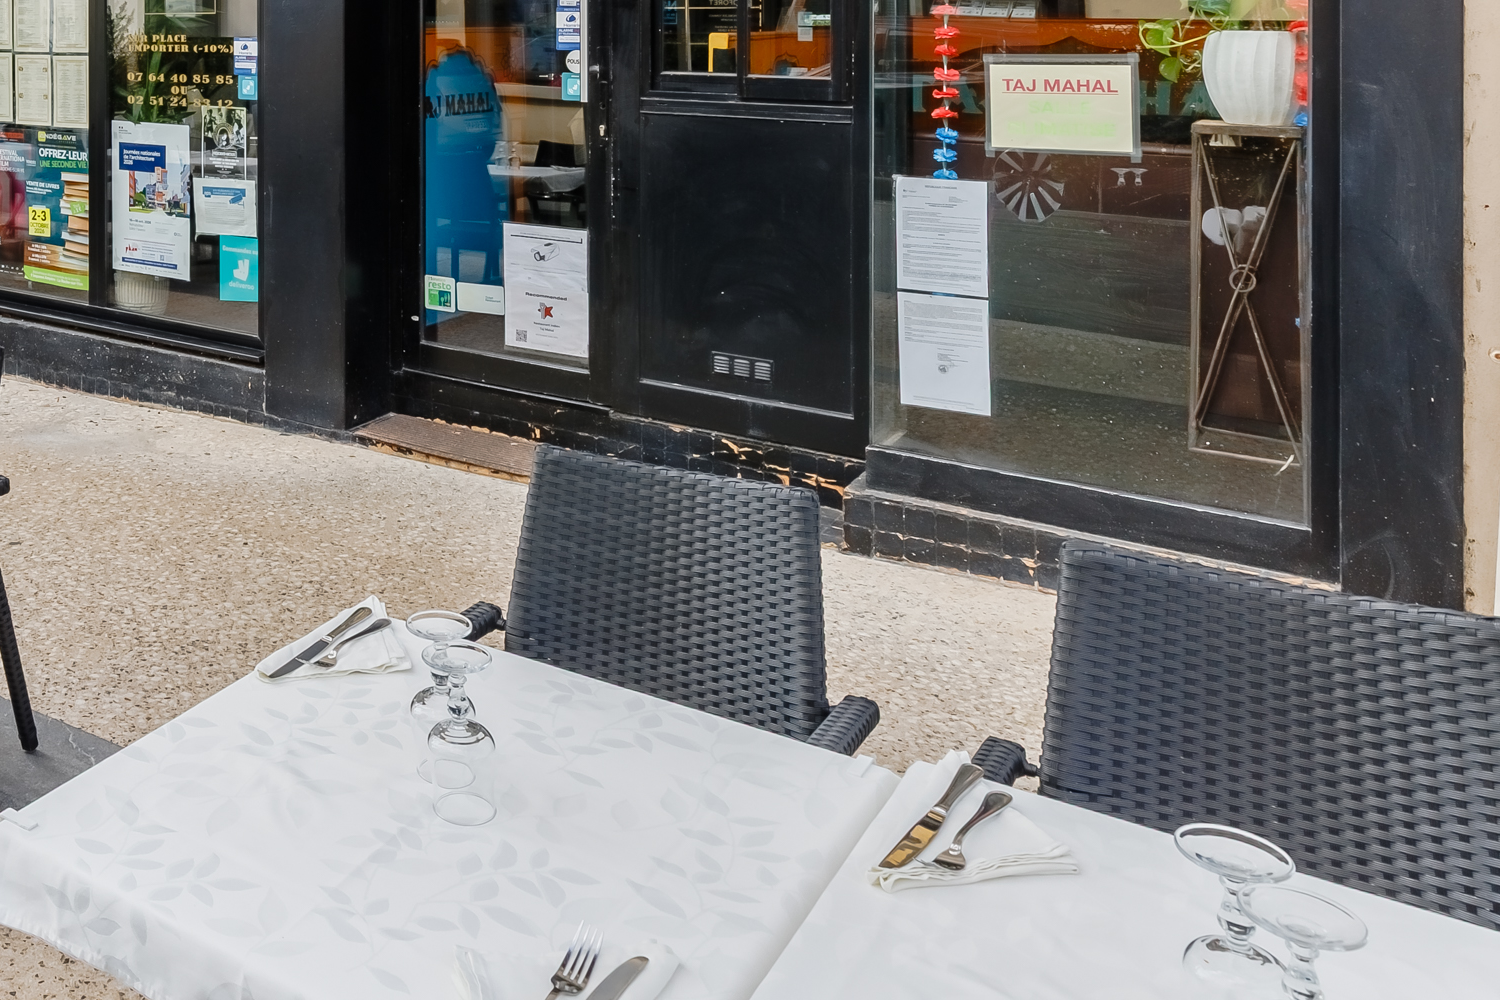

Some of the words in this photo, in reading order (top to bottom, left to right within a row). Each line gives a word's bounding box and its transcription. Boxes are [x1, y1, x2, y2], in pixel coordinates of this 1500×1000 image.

[152, 34, 187, 43] PLACE
[193, 44, 234, 54] (-10%)
[127, 72, 144, 82] 07
[148, 72, 165, 82] 64
[170, 73, 187, 83] 40
[193, 74, 210, 84] 85
[216, 74, 234, 85] 85
[170, 85, 188, 95] OU
[1002, 78, 1036, 92] TAJ
[1043, 79, 1119, 93] MAHAL
[127, 95, 144, 105] 02
[149, 96, 164, 106] 51
[170, 97, 187, 107] 24
[217, 99, 233, 109] 12
[445, 91, 494, 117] MAHAL
[1028, 101, 1091, 115] SALLE
[38, 147, 88, 161] OFFREZ-LEUR
[51, 160, 77, 168] SECONDE
[78, 161, 87, 169] VIE
[31, 210, 47, 222] 2-3
[228, 280, 255, 291] deliveroo
[428, 281, 452, 291] resto
[525, 291, 568, 302] Recommended
